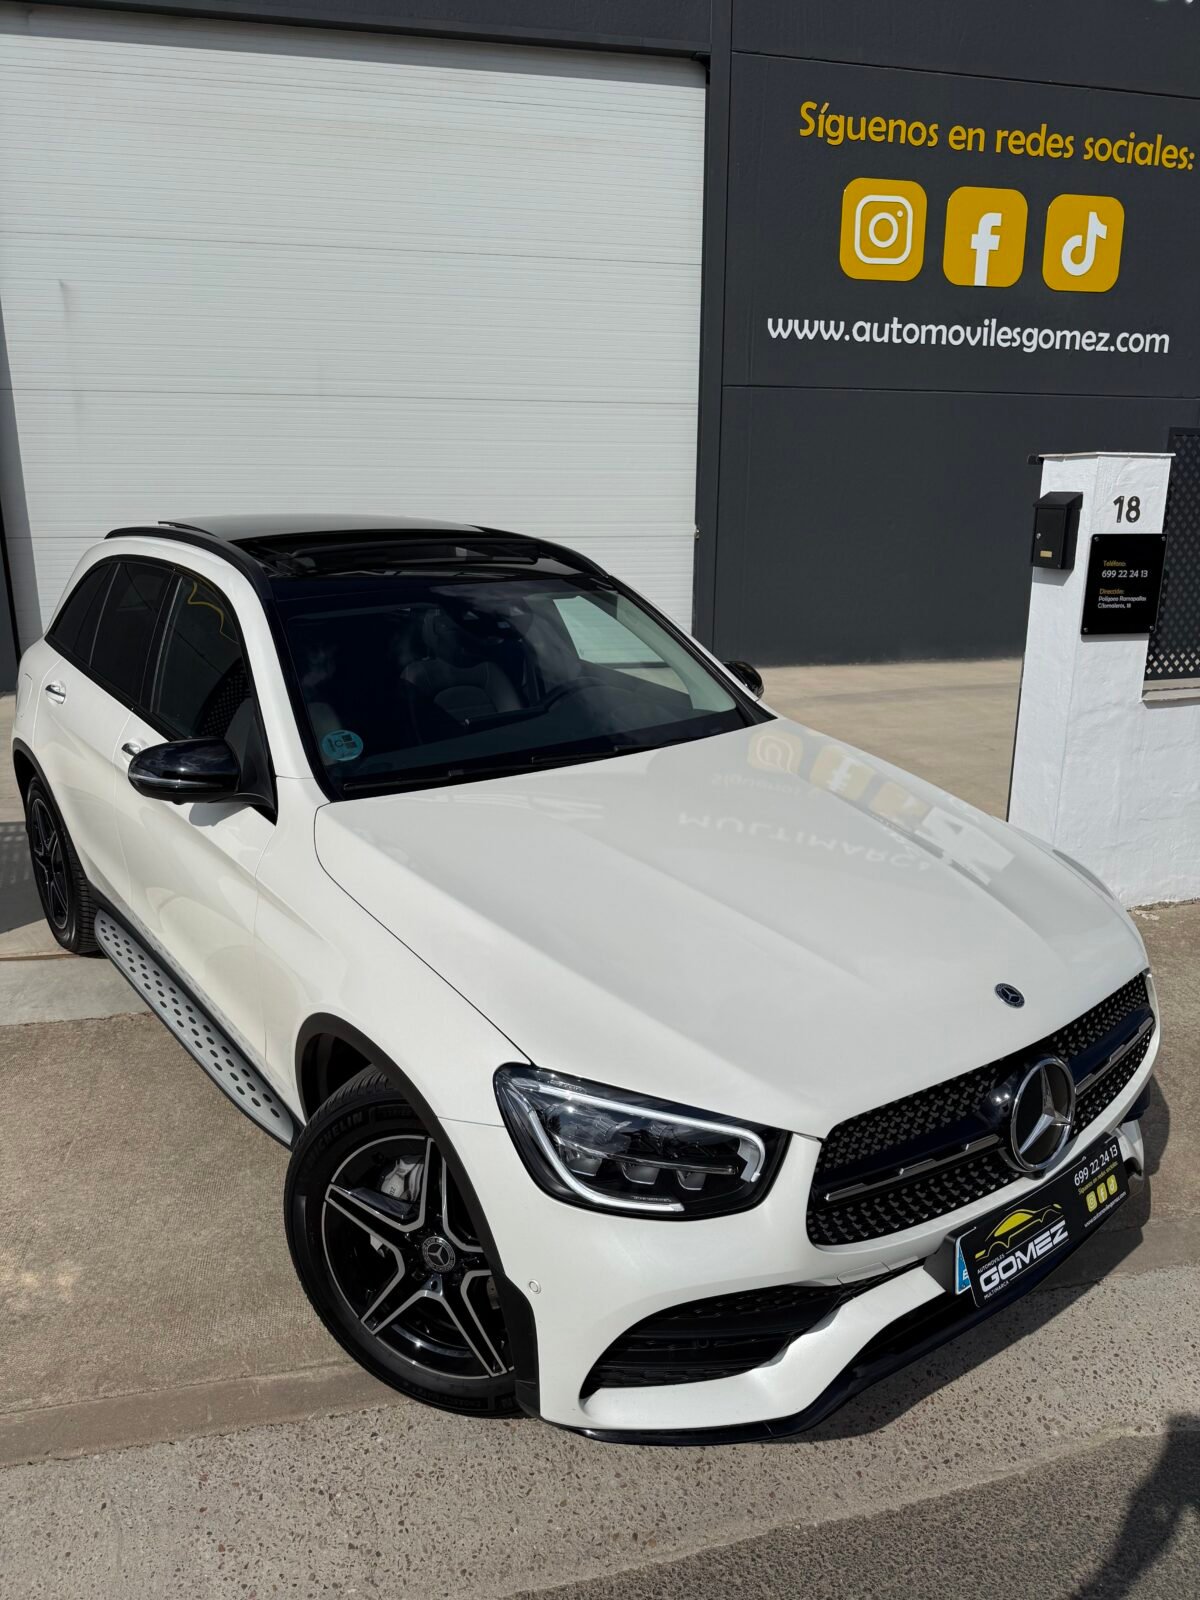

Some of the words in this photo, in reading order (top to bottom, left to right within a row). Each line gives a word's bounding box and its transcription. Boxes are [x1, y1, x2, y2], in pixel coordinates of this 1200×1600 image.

[799, 101, 939, 146] Síguenos
[948, 125, 986, 152] en
[995, 124, 1075, 159] redes
[1083, 132, 1196, 170] sociales:
[767, 316, 1171, 354] www.automovilesgomez.com
[1113, 495, 1141, 524] 18
[1101, 569, 1117, 578] 699
[1117, 569, 1128, 578] 22
[1129, 569, 1139, 578] 24
[1140, 569, 1149, 578] 13
[1074, 1166, 1089, 1186] 699
[1089, 1159, 1100, 1174] 22
[1099, 1151, 1110, 1167] 24
[1110, 1144, 1119, 1160] 13
[977, 1253, 1005, 1274] AUTOMOVILES
[979, 1219, 1069, 1293] GOMEZ
[983, 1280, 1009, 1301] MULTIMARCA
